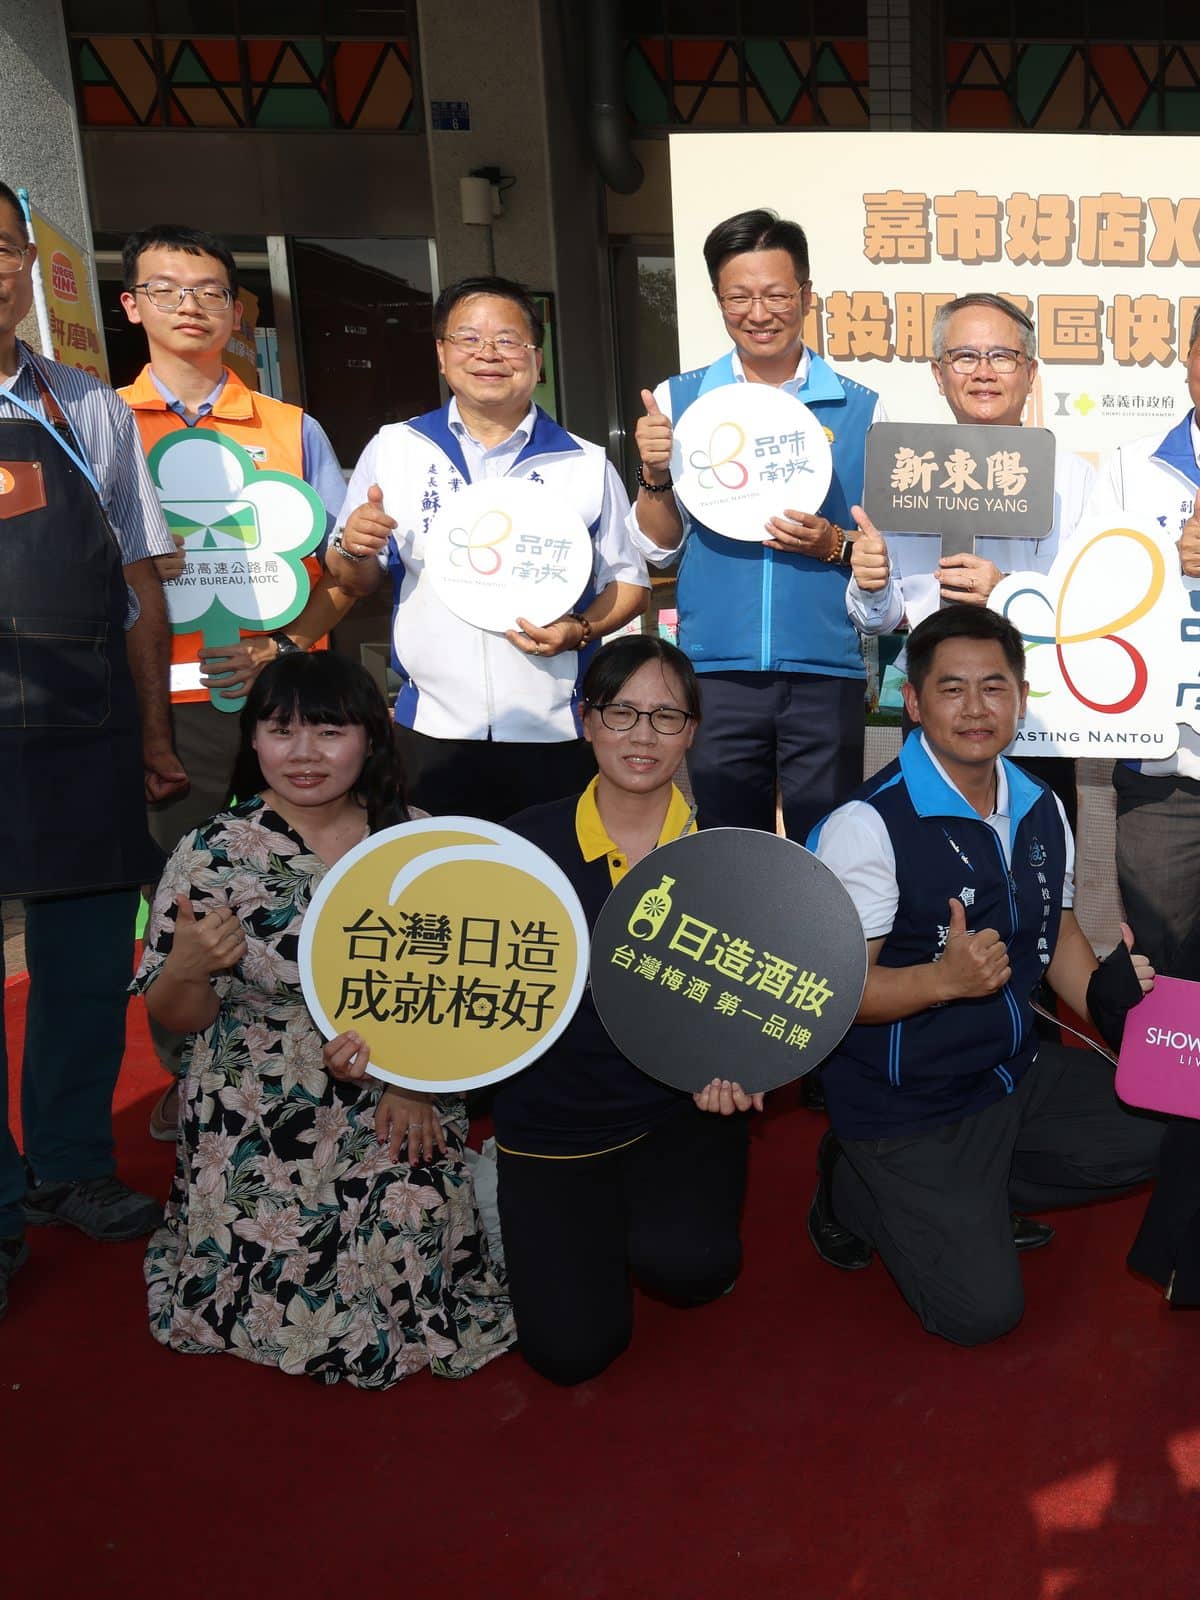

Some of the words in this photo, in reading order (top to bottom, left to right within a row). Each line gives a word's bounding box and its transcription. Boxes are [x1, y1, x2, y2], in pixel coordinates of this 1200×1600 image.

[52, 276, 78, 294] KING
[1102, 394, 1175, 409] 嘉義市政府
[755, 430, 806, 458] 品味
[760, 458, 815, 484] 南投
[890, 446, 1030, 497] 新東陽
[892, 495, 929, 510] HSIN
[936, 496, 980, 511] TUNG
[984, 498, 1028, 513] YANG
[515, 534, 573, 563] 品味
[200, 576, 246, 586] BUREAU,
[248, 575, 279, 584] MOTC
[511, 561, 569, 585] 南投
[342, 907, 560, 974] 台灣日造
[668, 913, 834, 1018] 日造酒妝
[334, 969, 557, 1033] 成就梅好
[611, 944, 712, 1004] 台灣梅酒
[713, 991, 812, 1050] 第一品牌
